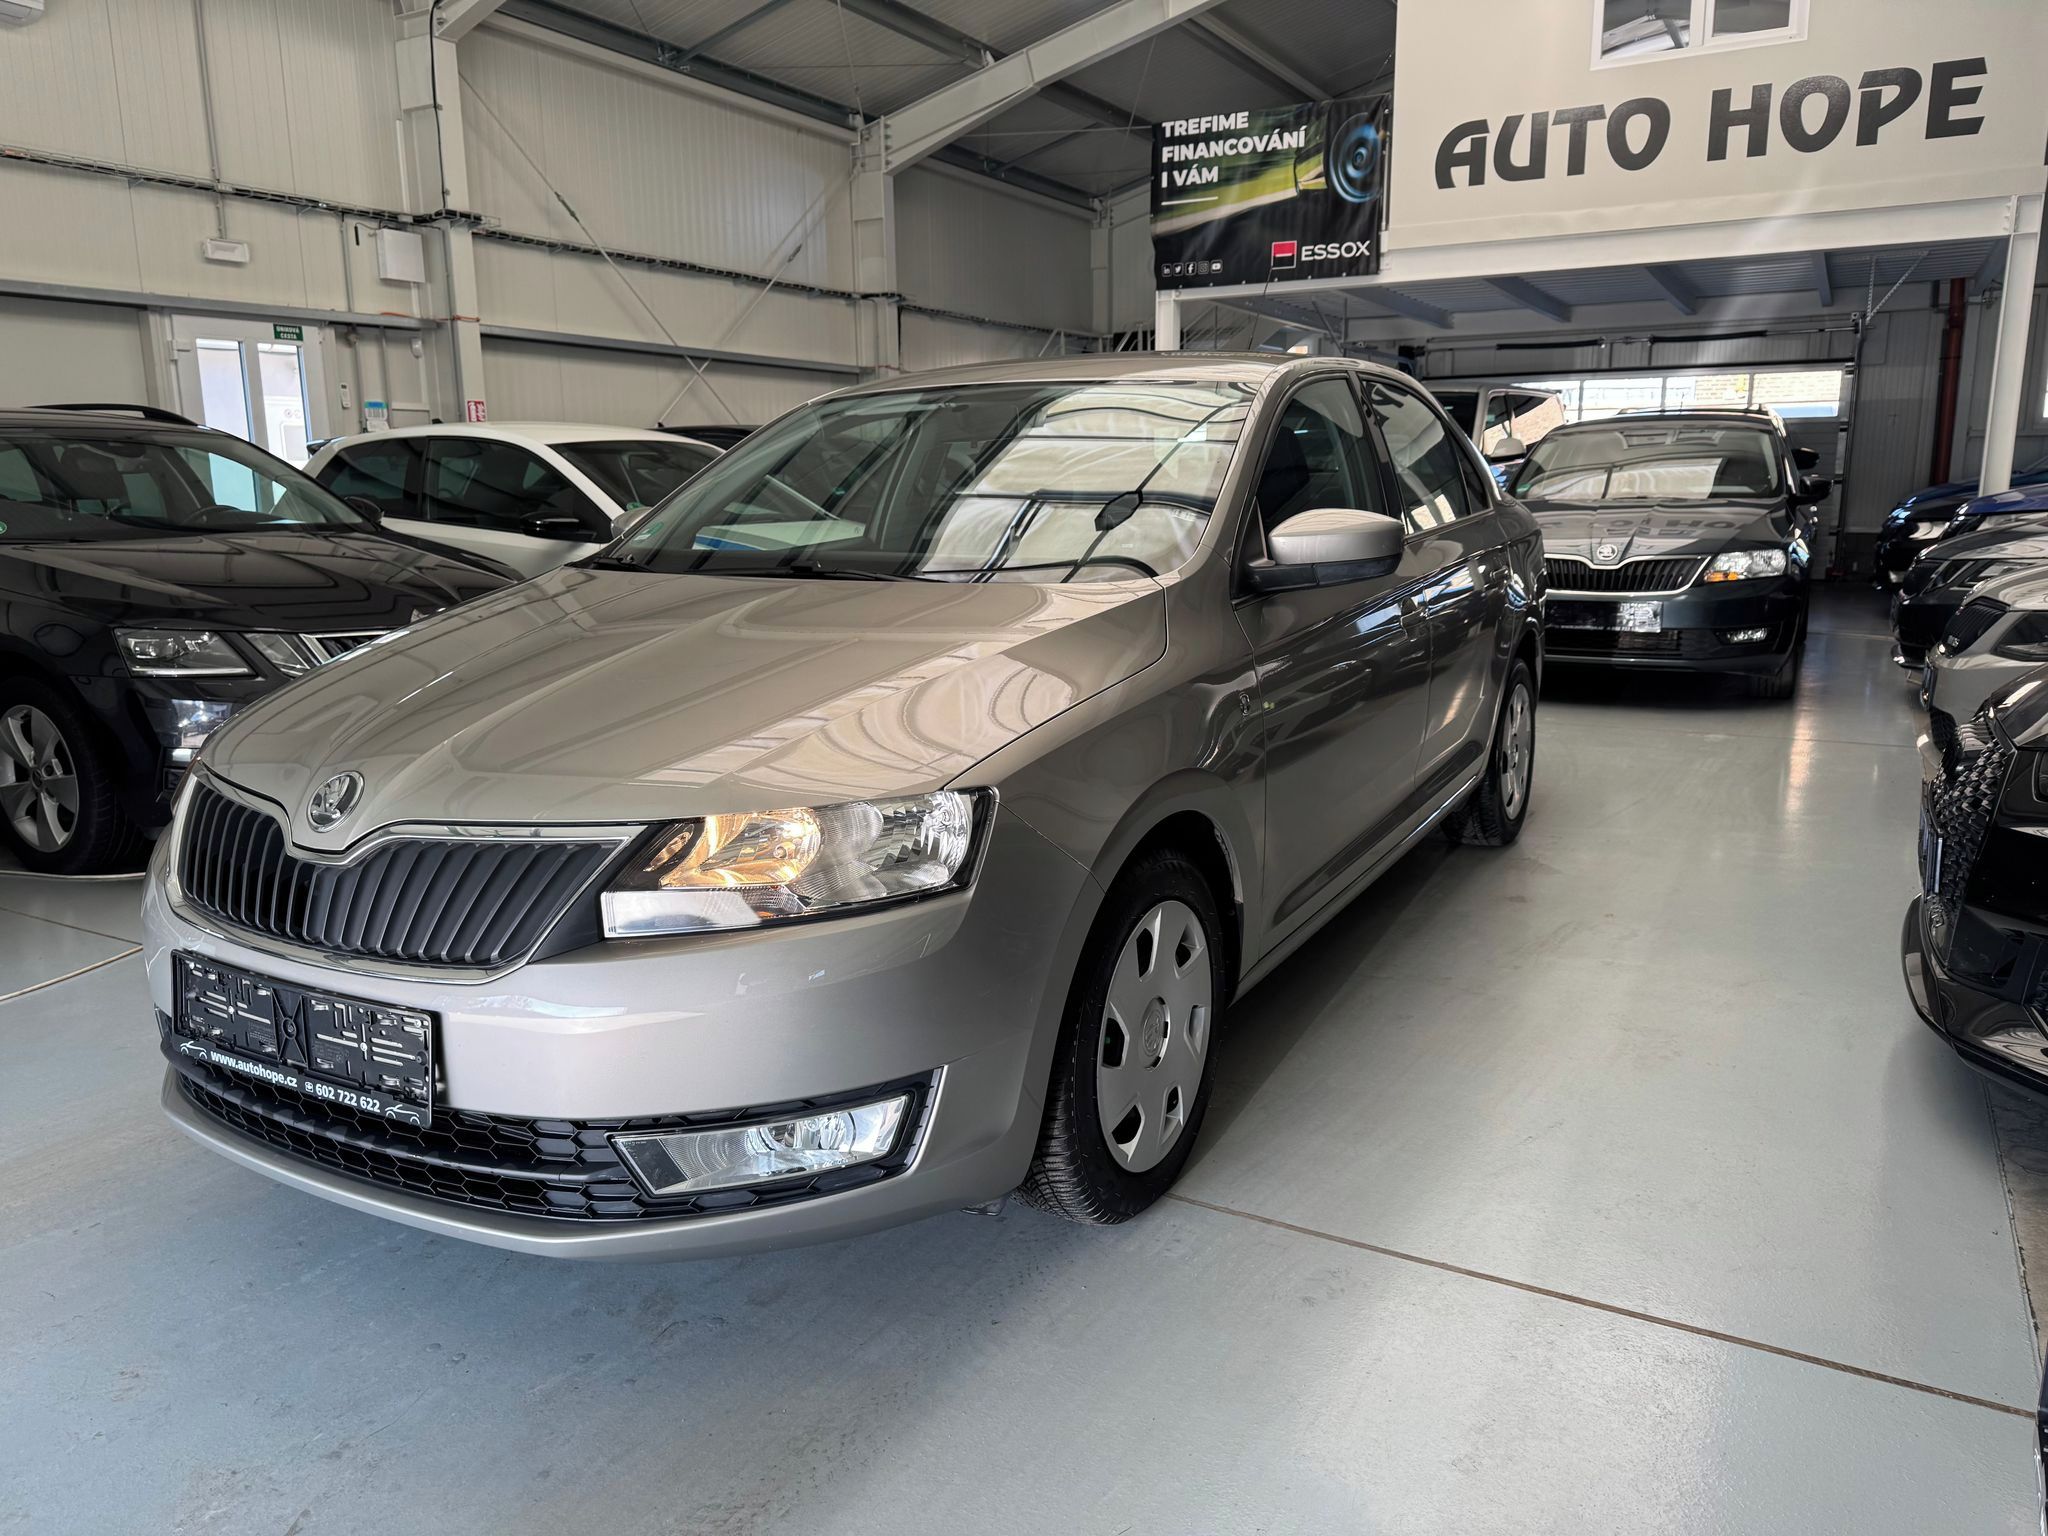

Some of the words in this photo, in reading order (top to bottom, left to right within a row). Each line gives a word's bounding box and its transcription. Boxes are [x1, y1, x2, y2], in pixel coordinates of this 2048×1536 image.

[1162, 111, 1249, 138] TREFIME
[1434, 97, 1671, 190] AUTO
[1706, 56, 1988, 163] HOPE
[1162, 126, 1308, 163] FINANCOVÁNÍ
[1161, 171, 1168, 188] I
[1172, 164, 1219, 187] VÁM
[1301, 240, 1371, 262] ESSOX
[210, 1050, 298, 1088] www.autohope.cz
[315, 1083, 336, 1100] 602
[337, 1089, 358, 1107] 722
[359, 1095, 381, 1113] 622
